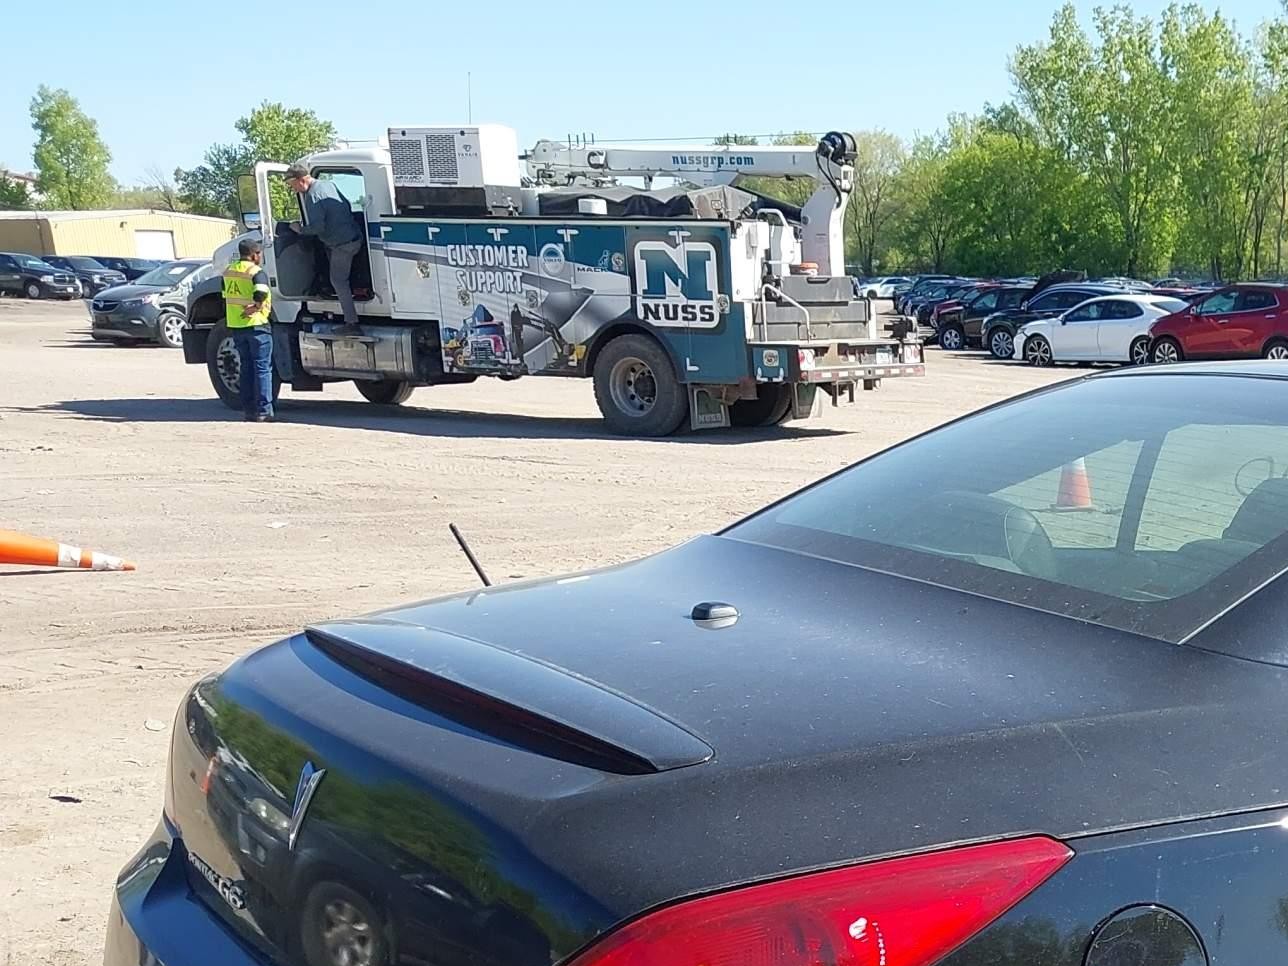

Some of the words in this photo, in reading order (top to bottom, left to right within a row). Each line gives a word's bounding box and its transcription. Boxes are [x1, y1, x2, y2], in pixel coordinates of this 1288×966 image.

[672, 155, 754, 168] nussgrp.com
[447, 244, 529, 267] CUSTOMER
[456, 270, 523, 294] SUPPORT
[641, 303, 715, 323] NUSS
[219, 877, 244, 909] G6
